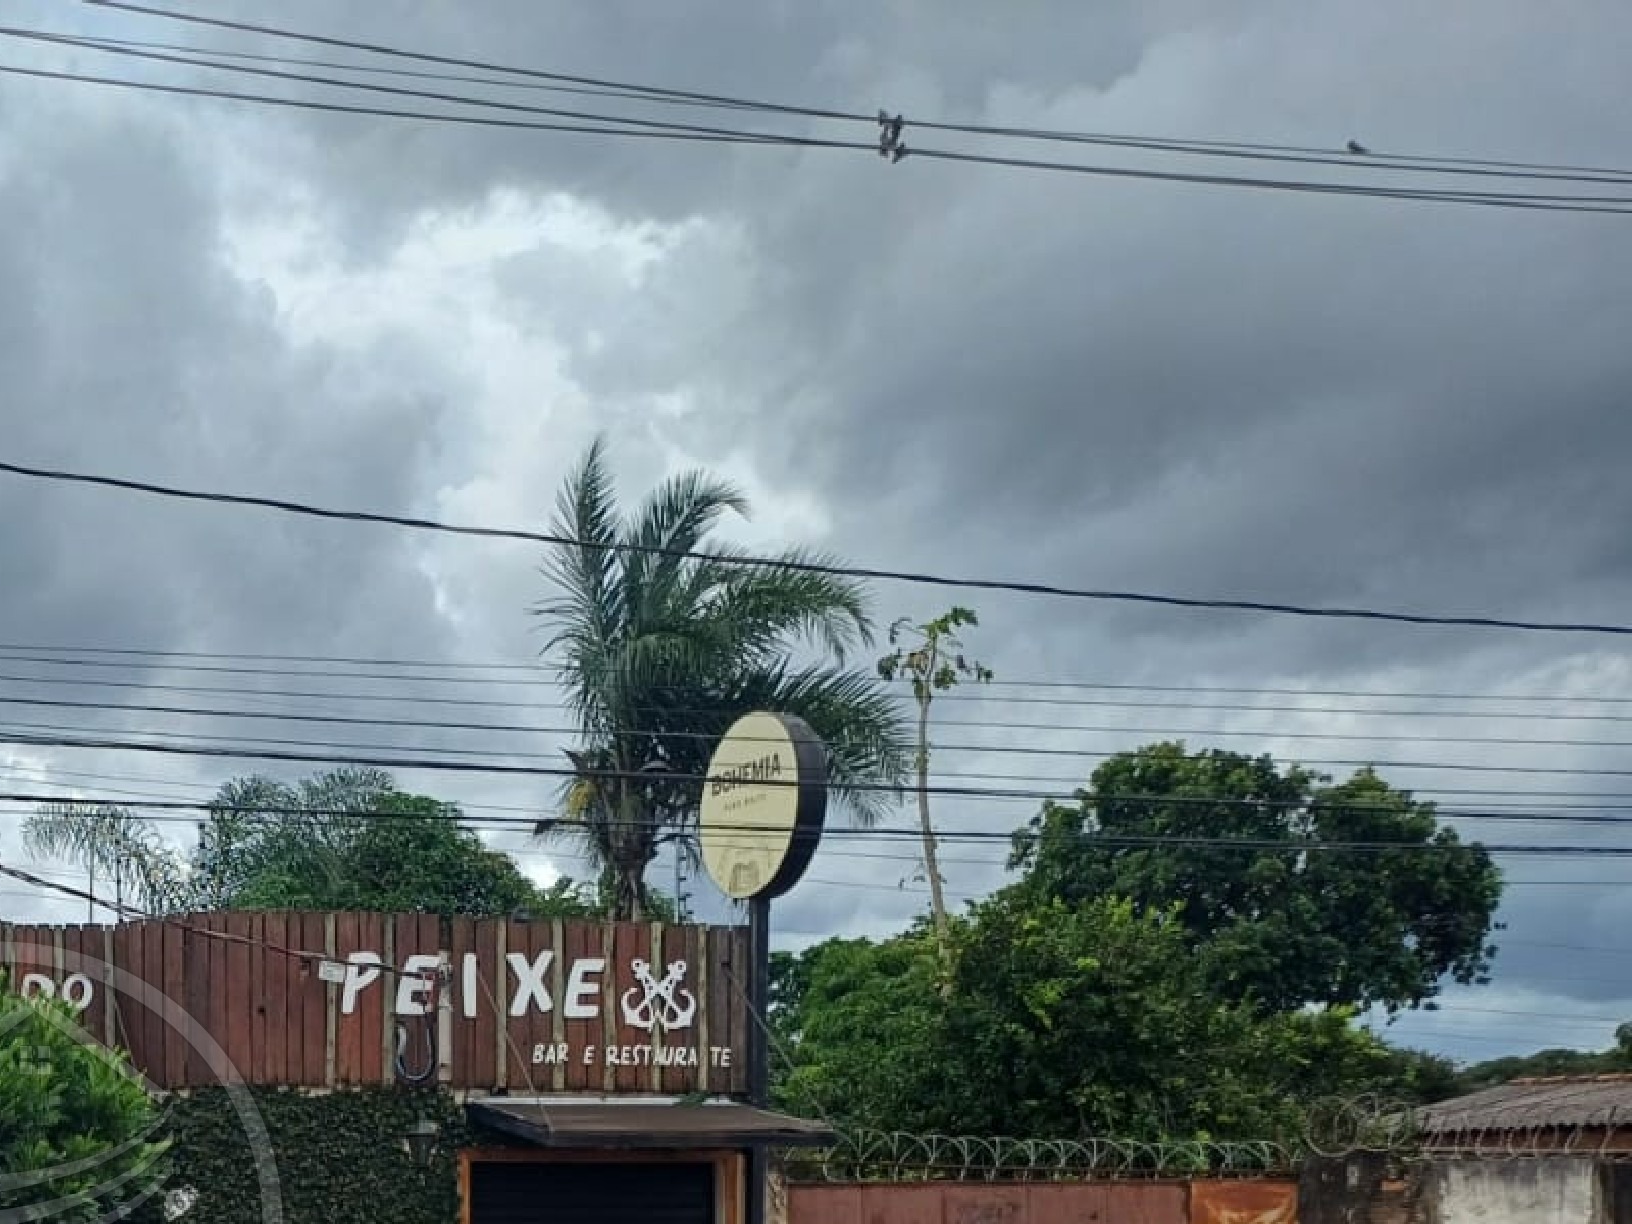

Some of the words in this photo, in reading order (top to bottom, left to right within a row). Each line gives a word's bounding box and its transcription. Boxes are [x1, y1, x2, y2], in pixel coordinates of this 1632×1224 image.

[342, 950, 606, 1018] PEIXE
[532, 1042, 569, 1064] BAR
[583, 1044, 596, 1066] E
